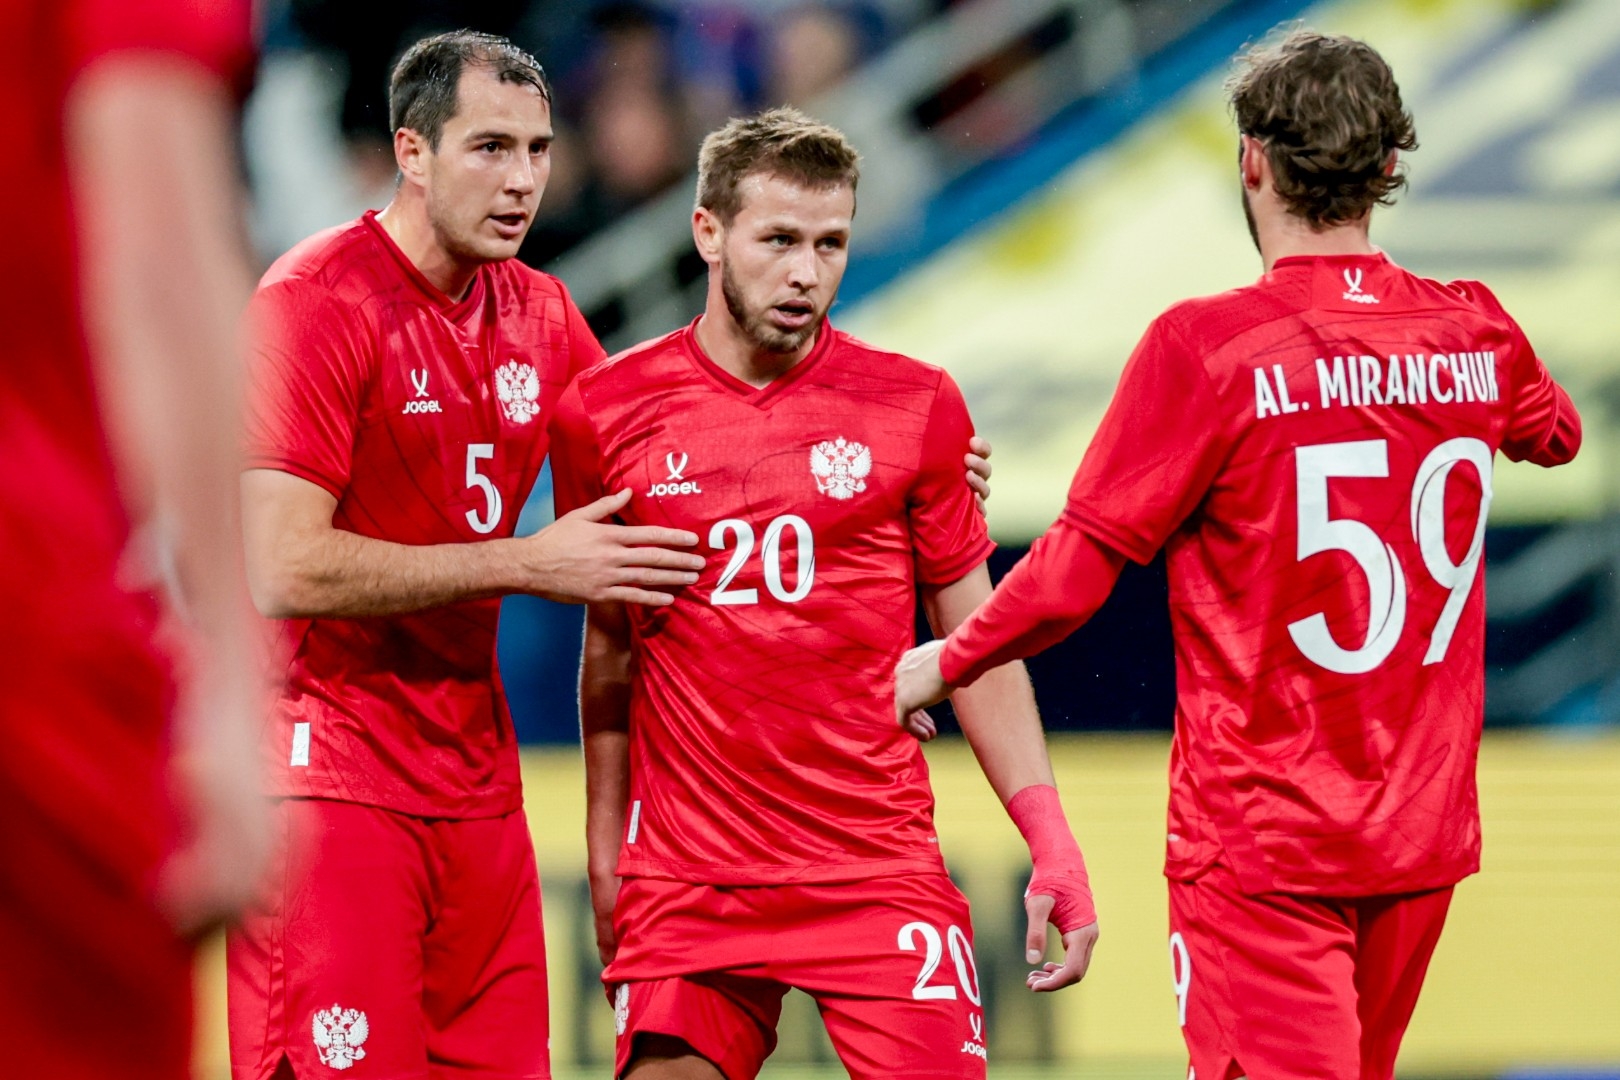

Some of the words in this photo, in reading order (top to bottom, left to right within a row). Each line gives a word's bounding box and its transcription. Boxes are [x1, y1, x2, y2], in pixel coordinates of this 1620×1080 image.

[1254, 364, 1310, 419] AL.
[1315, 351, 1498, 409] MIRANCHUK
[465, 443, 502, 534] 5
[646, 481, 702, 497] JOGEL
[708, 514, 815, 605] 20
[1287, 437, 1494, 675] 59
[897, 921, 981, 1007] 20
